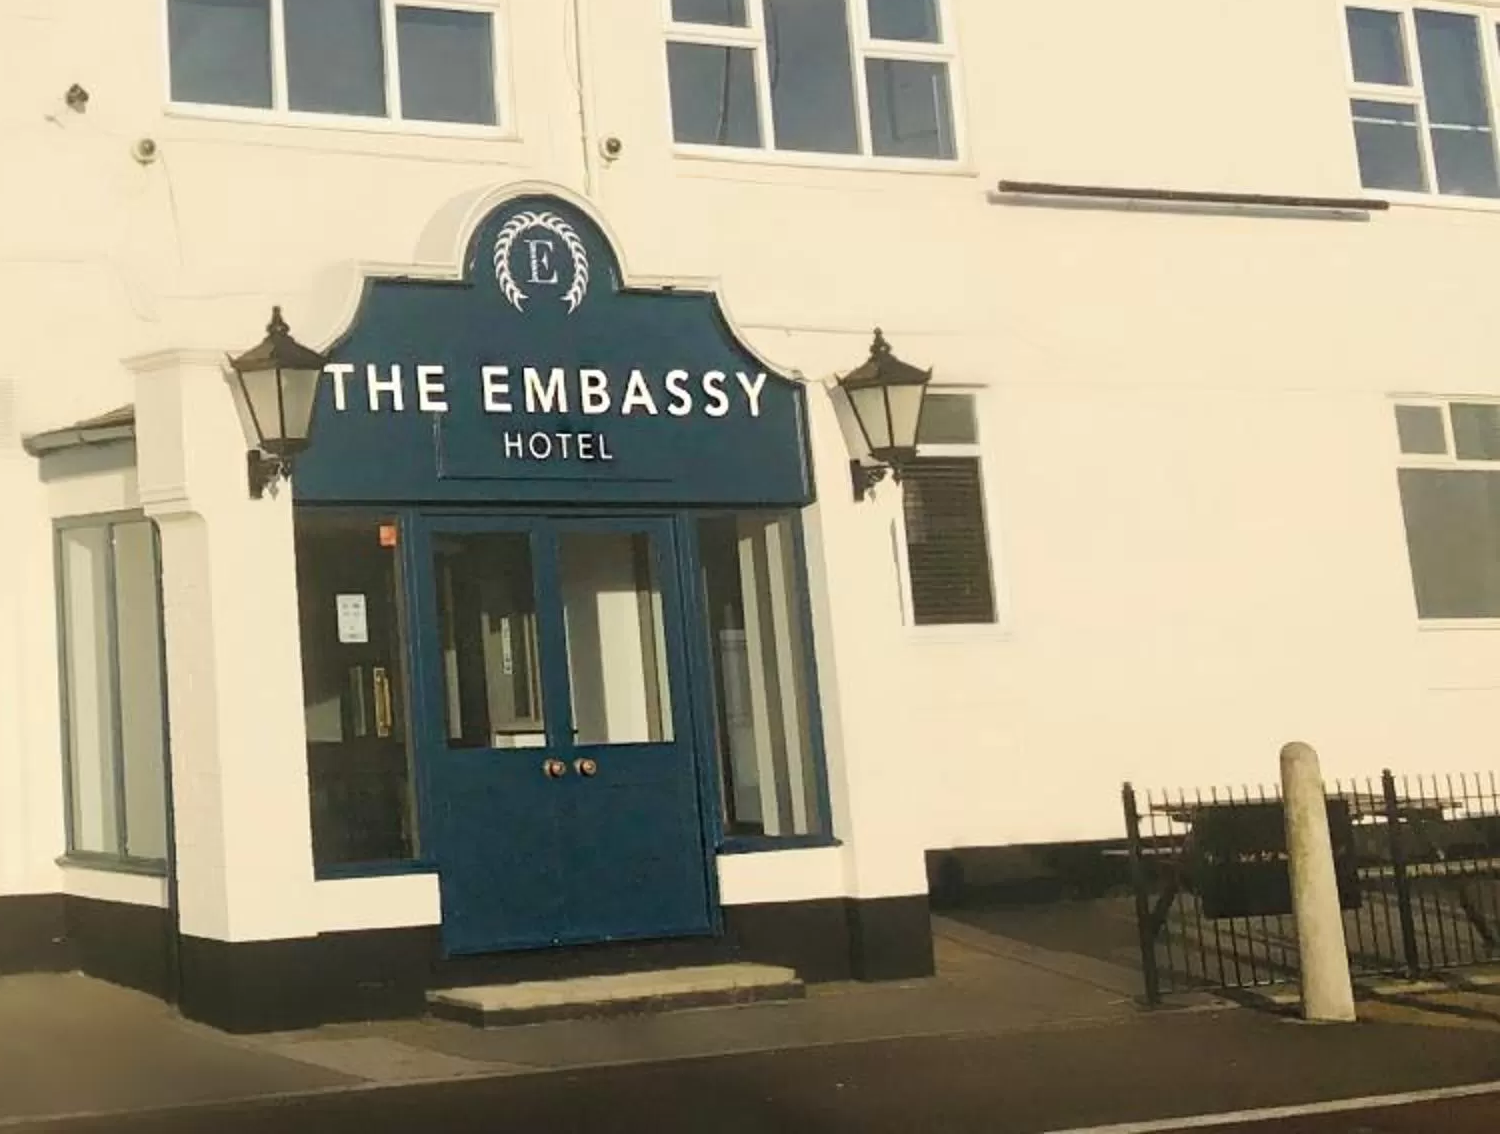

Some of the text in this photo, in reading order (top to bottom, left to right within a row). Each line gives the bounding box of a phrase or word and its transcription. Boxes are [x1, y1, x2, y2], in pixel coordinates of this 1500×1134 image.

[524, 238, 560, 285] E
[324, 363, 768, 417] THE EMBASSY
[504, 432, 613, 459] HOTEL
